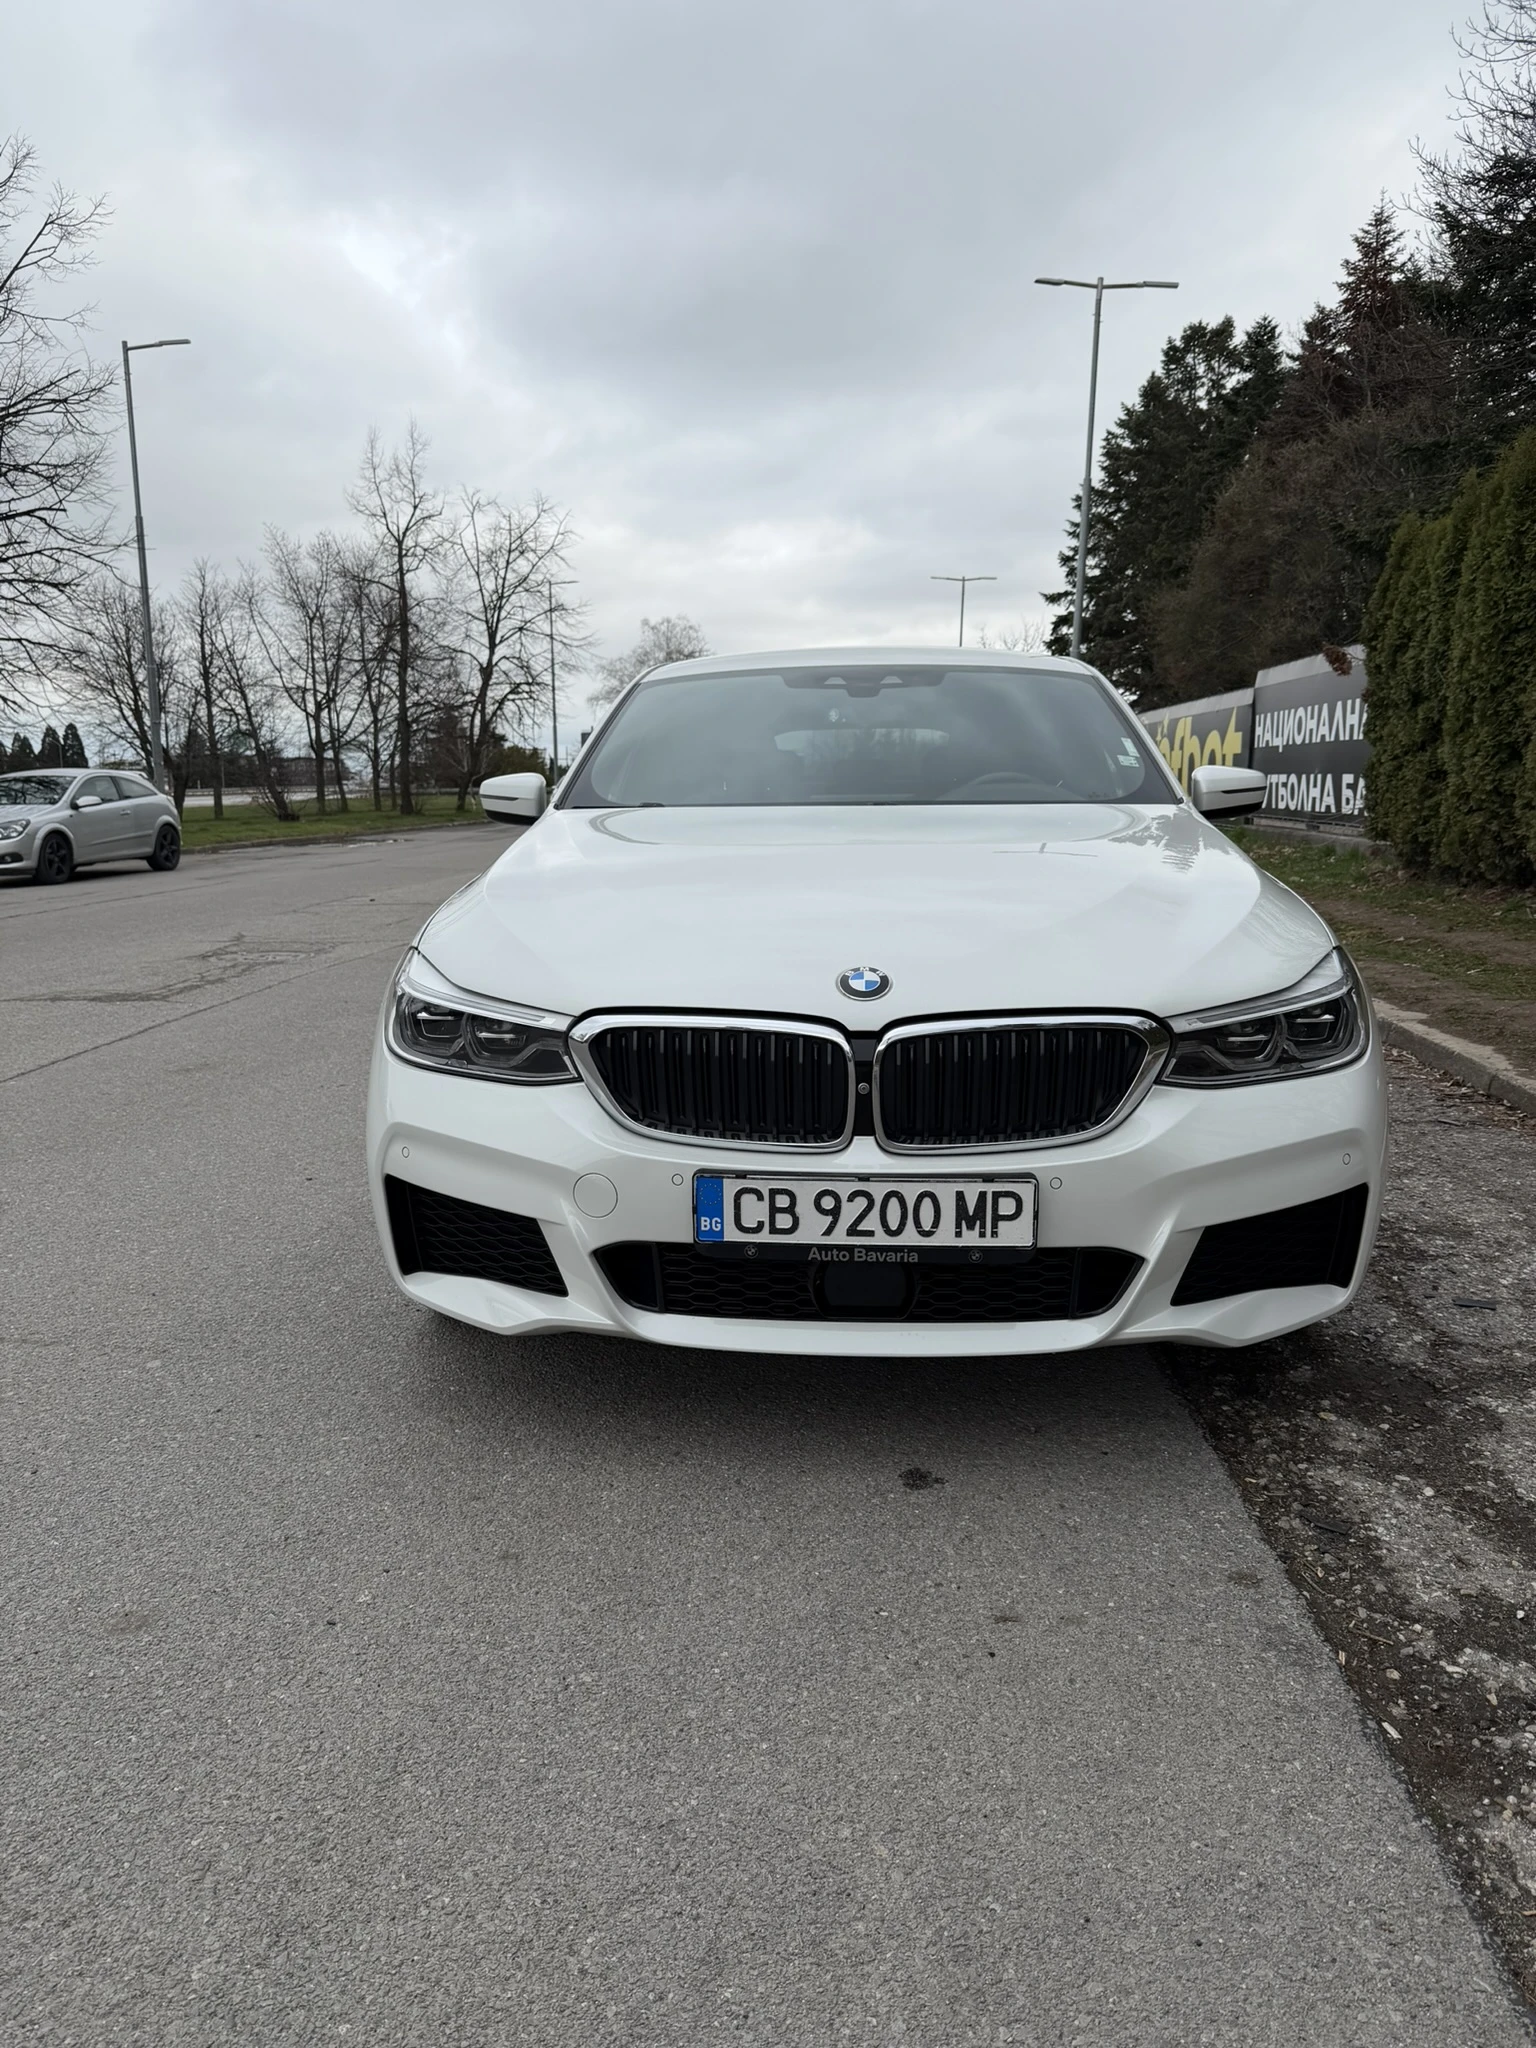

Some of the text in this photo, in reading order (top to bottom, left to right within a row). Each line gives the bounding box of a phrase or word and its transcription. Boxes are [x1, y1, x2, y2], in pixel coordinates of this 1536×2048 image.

[1341, 773, 1370, 817] БА
[700, 1216, 722, 1231] BG
[733, 1187, 1023, 1238] CB 9200 MP
[808, 1248, 919, 1263] Auto Bavaria
